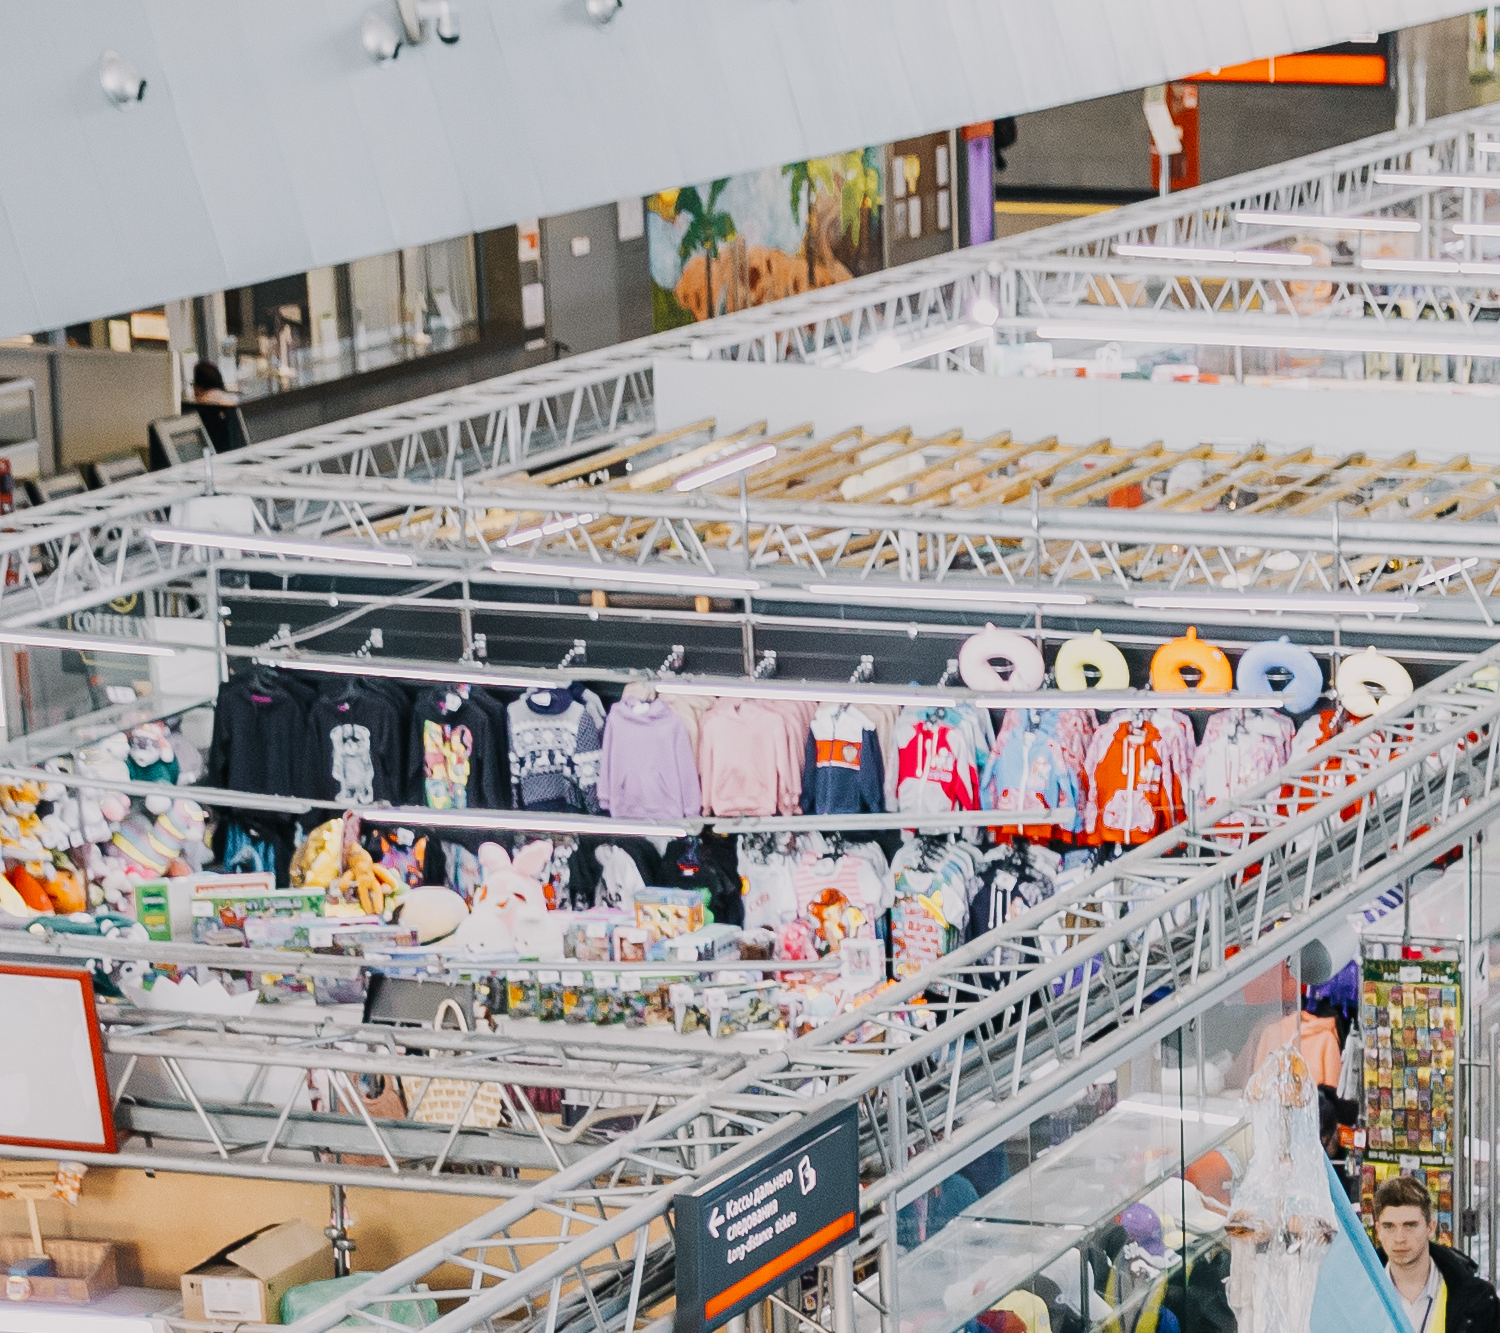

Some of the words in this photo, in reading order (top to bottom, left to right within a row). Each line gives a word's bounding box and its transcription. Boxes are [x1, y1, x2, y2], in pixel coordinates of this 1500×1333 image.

[726, 1191, 753, 1220] Кассы
[753, 1167, 794, 1207] дальнего
[726, 1198, 779, 1242] следования
[775, 1211, 797, 1234] tickets
